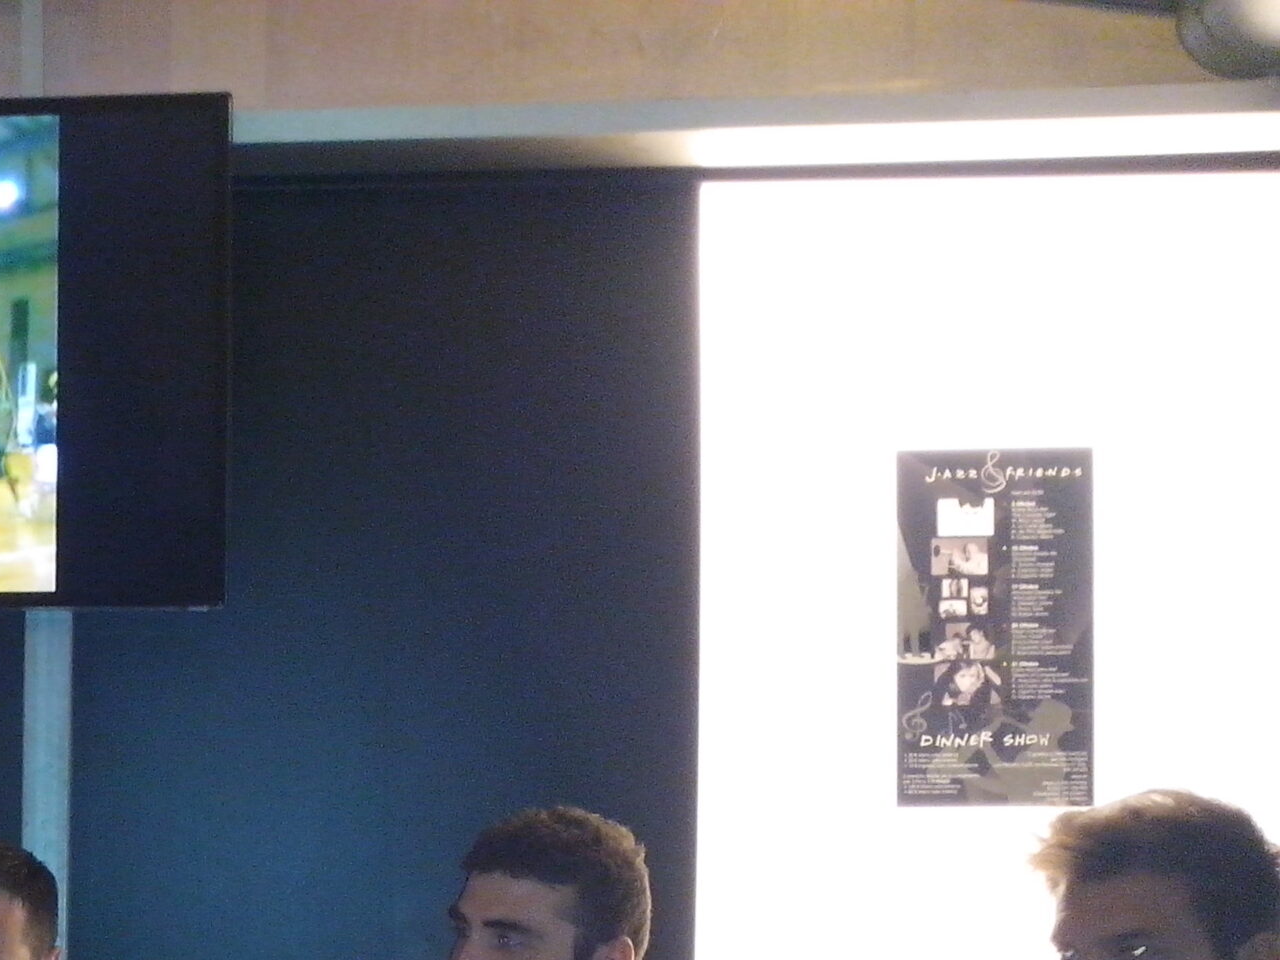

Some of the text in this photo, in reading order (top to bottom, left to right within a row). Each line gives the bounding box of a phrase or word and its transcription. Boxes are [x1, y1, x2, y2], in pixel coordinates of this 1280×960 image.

[925, 466, 978, 483] JAZZ
[1006, 466, 1082, 481] FRIENDS
[920, 731, 1050, 748] DINNER SHOW
